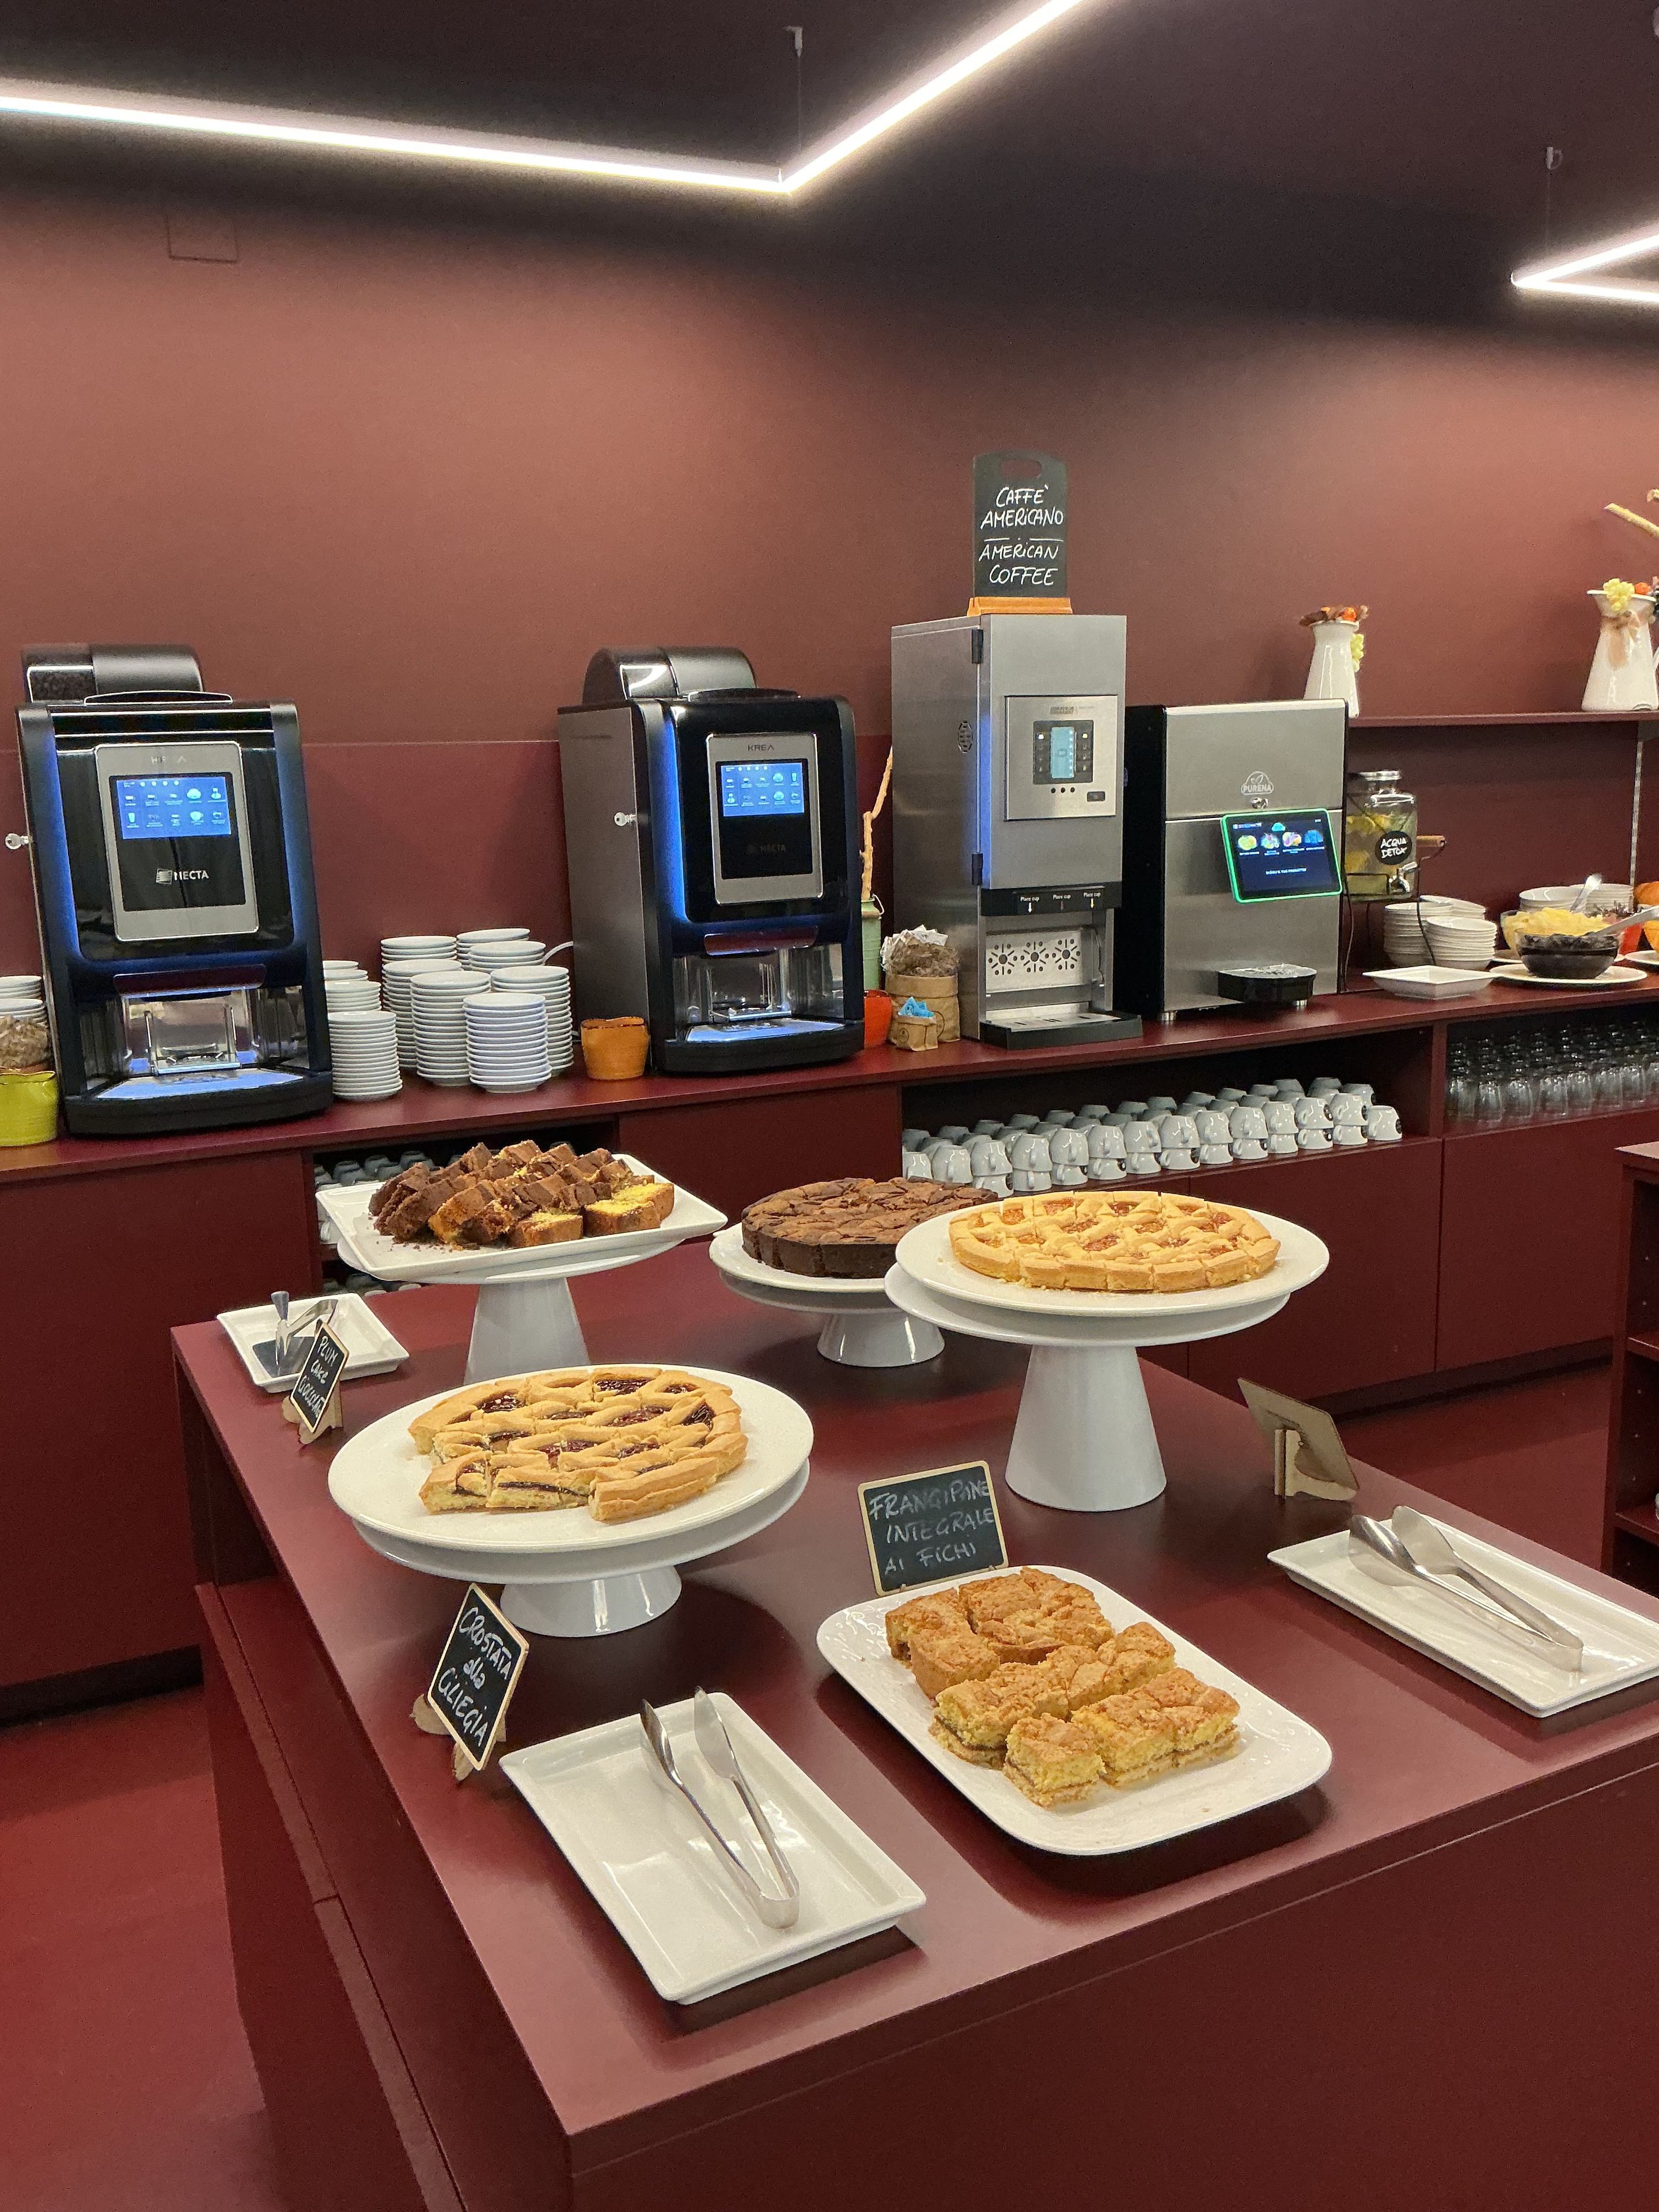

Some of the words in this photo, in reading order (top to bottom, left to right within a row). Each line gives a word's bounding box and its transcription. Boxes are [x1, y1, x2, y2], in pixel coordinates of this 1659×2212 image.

[989, 565, 1058, 586] COFFEE
[1243, 783, 1271, 793] PURENA
[1380, 836, 1407, 849] ACQUA
[1381, 847, 1407, 859] DETOX
[317, 1335, 338, 1368] PLUM
[310, 1359, 329, 1384] CAKE
[886, 1508, 995, 1544] INTEGRALE
[885, 1557, 904, 1576] AI
[916, 1539, 976, 1567] FICHI
